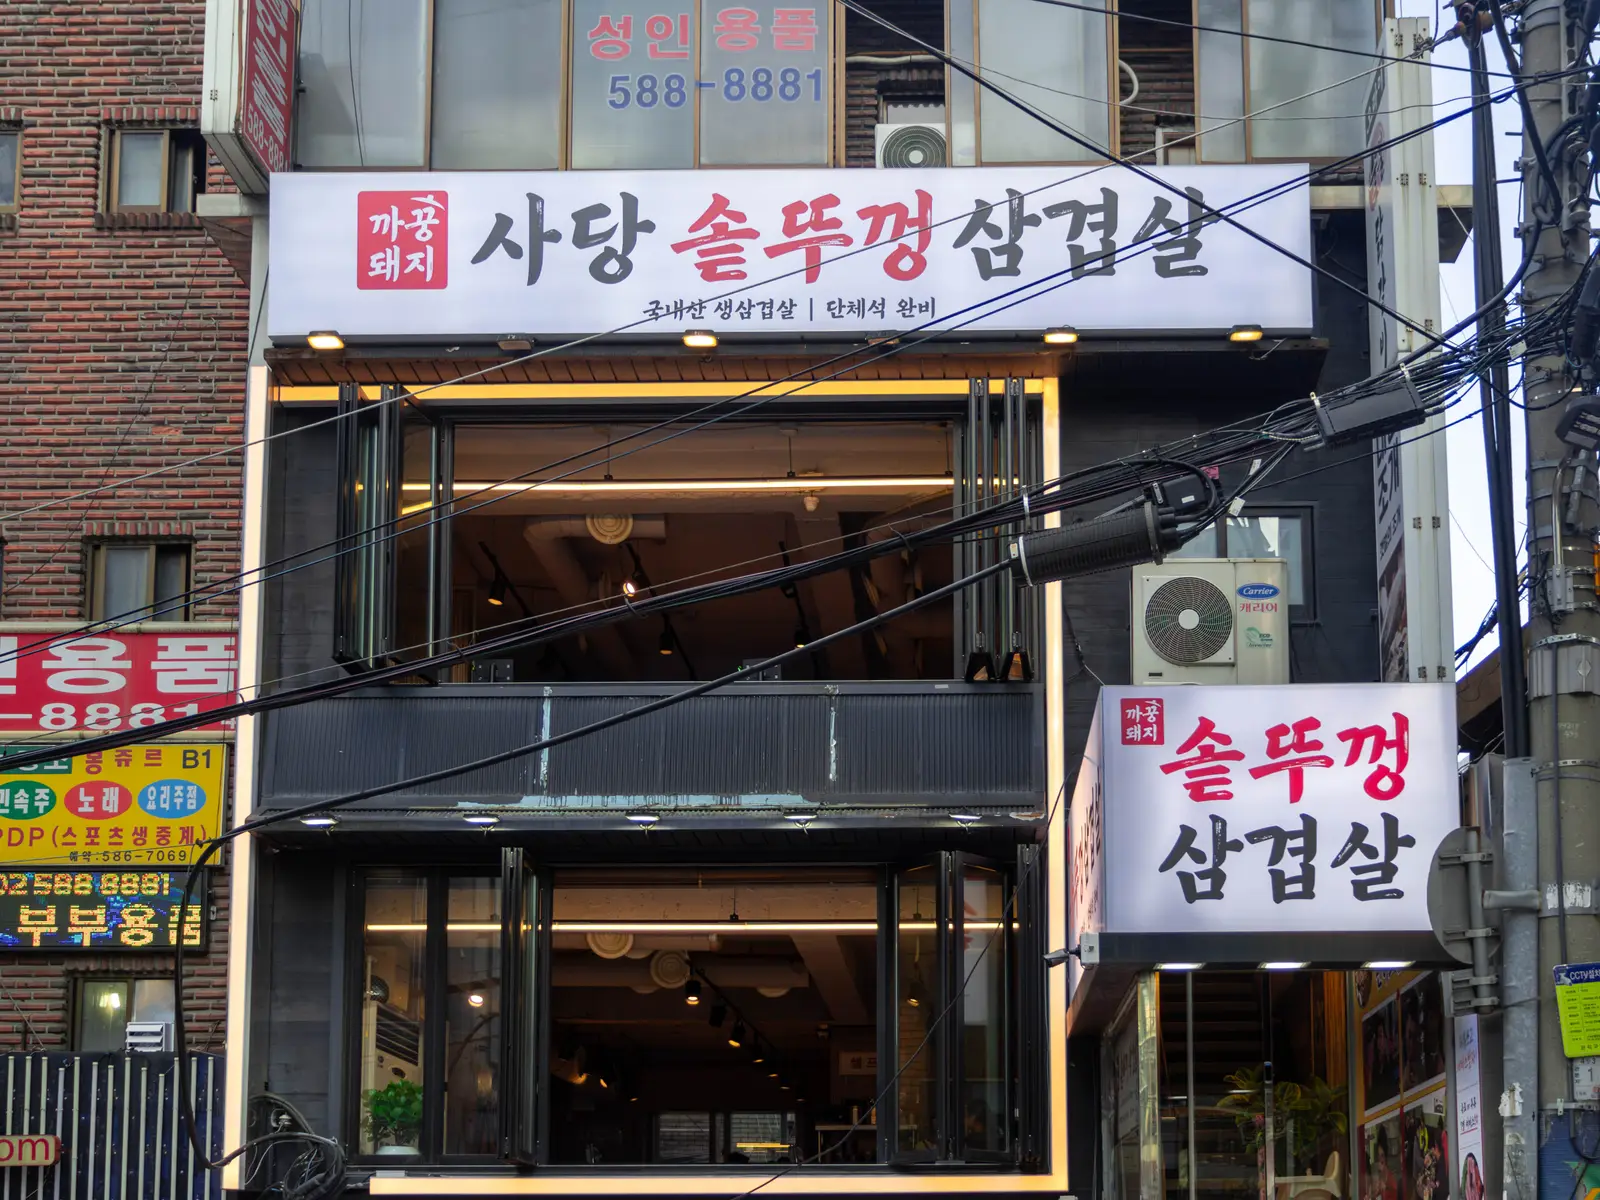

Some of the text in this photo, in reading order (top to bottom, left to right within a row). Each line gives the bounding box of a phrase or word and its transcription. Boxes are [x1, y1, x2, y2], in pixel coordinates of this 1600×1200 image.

[606, 67, 823, 109] 588-8881
[368, 197, 445, 243] 까꿍
[470, 186, 1224, 286] 사당 솥뚜껑 삼겹살
[368, 244, 435, 282] 돼지
[643, 296, 937, 321] 국내산 생삼겹살 단체석 완비
[1242, 587, 1274, 595] Carrier
[1240, 602, 1278, 613] 캐리어
[1125, 724, 1158, 742] 돼지
[181, 749, 211, 769] B1
[1159, 711, 1410, 804] 솥뚜껑
[78, 787, 120, 813] 노래
[146, 786, 197, 811] 요리주점
[0, 824, 207, 848] DP(스포츠생중계)
[1159, 812, 1416, 904] 삼겹살
[17, 904, 201, 947] 부부용품
